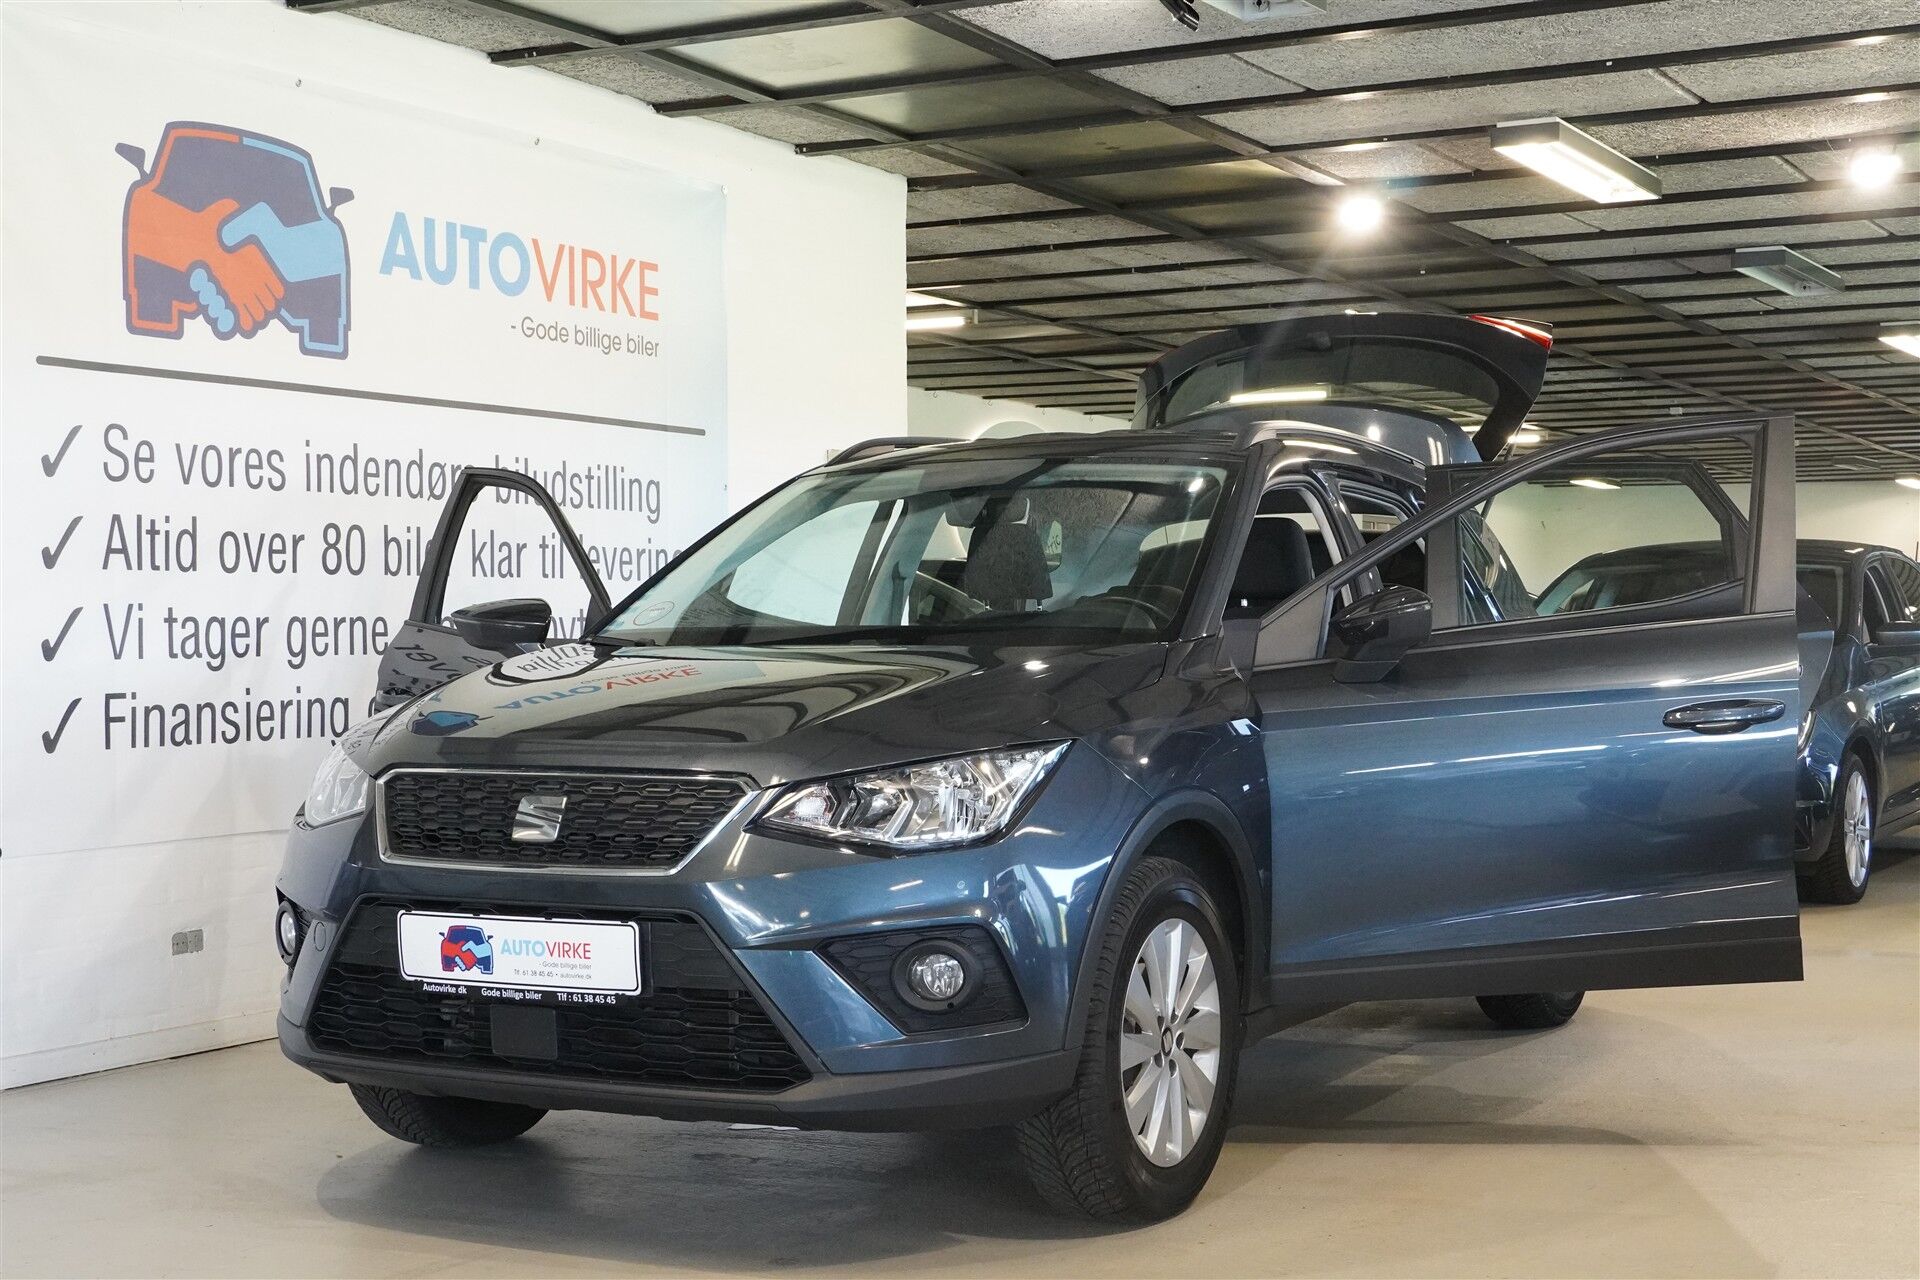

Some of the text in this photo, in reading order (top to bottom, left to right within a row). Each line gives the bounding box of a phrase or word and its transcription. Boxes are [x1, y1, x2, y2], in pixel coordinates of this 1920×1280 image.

[379, 211, 659, 321] AUTOVIRKE
[521, 316, 569, 343] Gode
[575, 324, 621, 355] billige
[627, 333, 659, 357] biler
[103, 423, 154, 483] Se
[175, 443, 286, 491] vores
[305, 439, 478, 503] indendør
[102, 514, 197, 573] Altid
[219, 530, 305, 574] over
[322, 522, 366, 576] 80
[472, 529, 527, 579] klar
[539, 532, 564, 579] til
[103, 603, 143, 660] Vi
[163, 607, 269, 672] tager
[287, 616, 388, 669] gerne
[104, 686, 349, 750] Finansiering
[500, 939, 591, 960] AUTOVIRKE
[481, 988, 542, 1000] Gode billige biler
[573, 994, 583, 1002] 61
[584, 994, 594, 1003] 38
[595, 995, 605, 1004] 45
[606, 996, 616, 1004] 45
